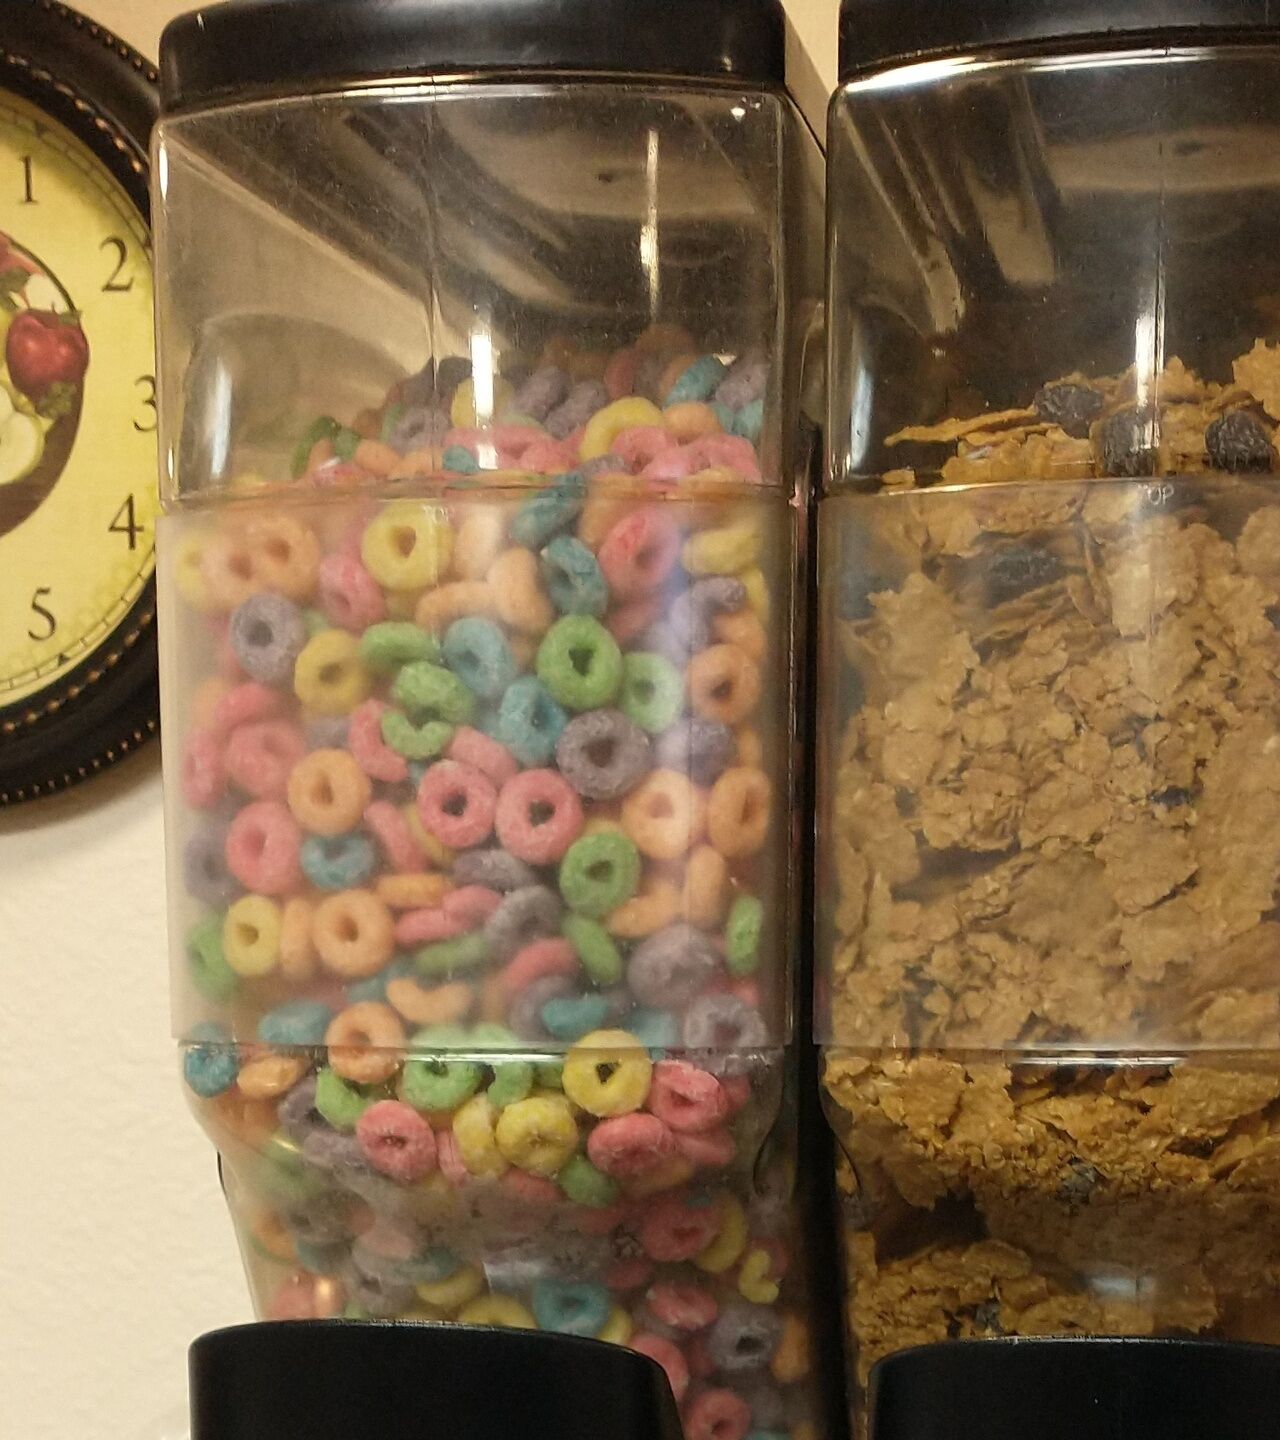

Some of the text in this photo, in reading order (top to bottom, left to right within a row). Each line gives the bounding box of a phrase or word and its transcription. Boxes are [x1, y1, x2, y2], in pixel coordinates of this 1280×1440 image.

[19, 155, 38, 204] 1
[99, 237, 137, 293] 2
[132, 373, 158, 433] 3
[107, 492, 146, 551] 4
[26, 586, 58, 643] 5
